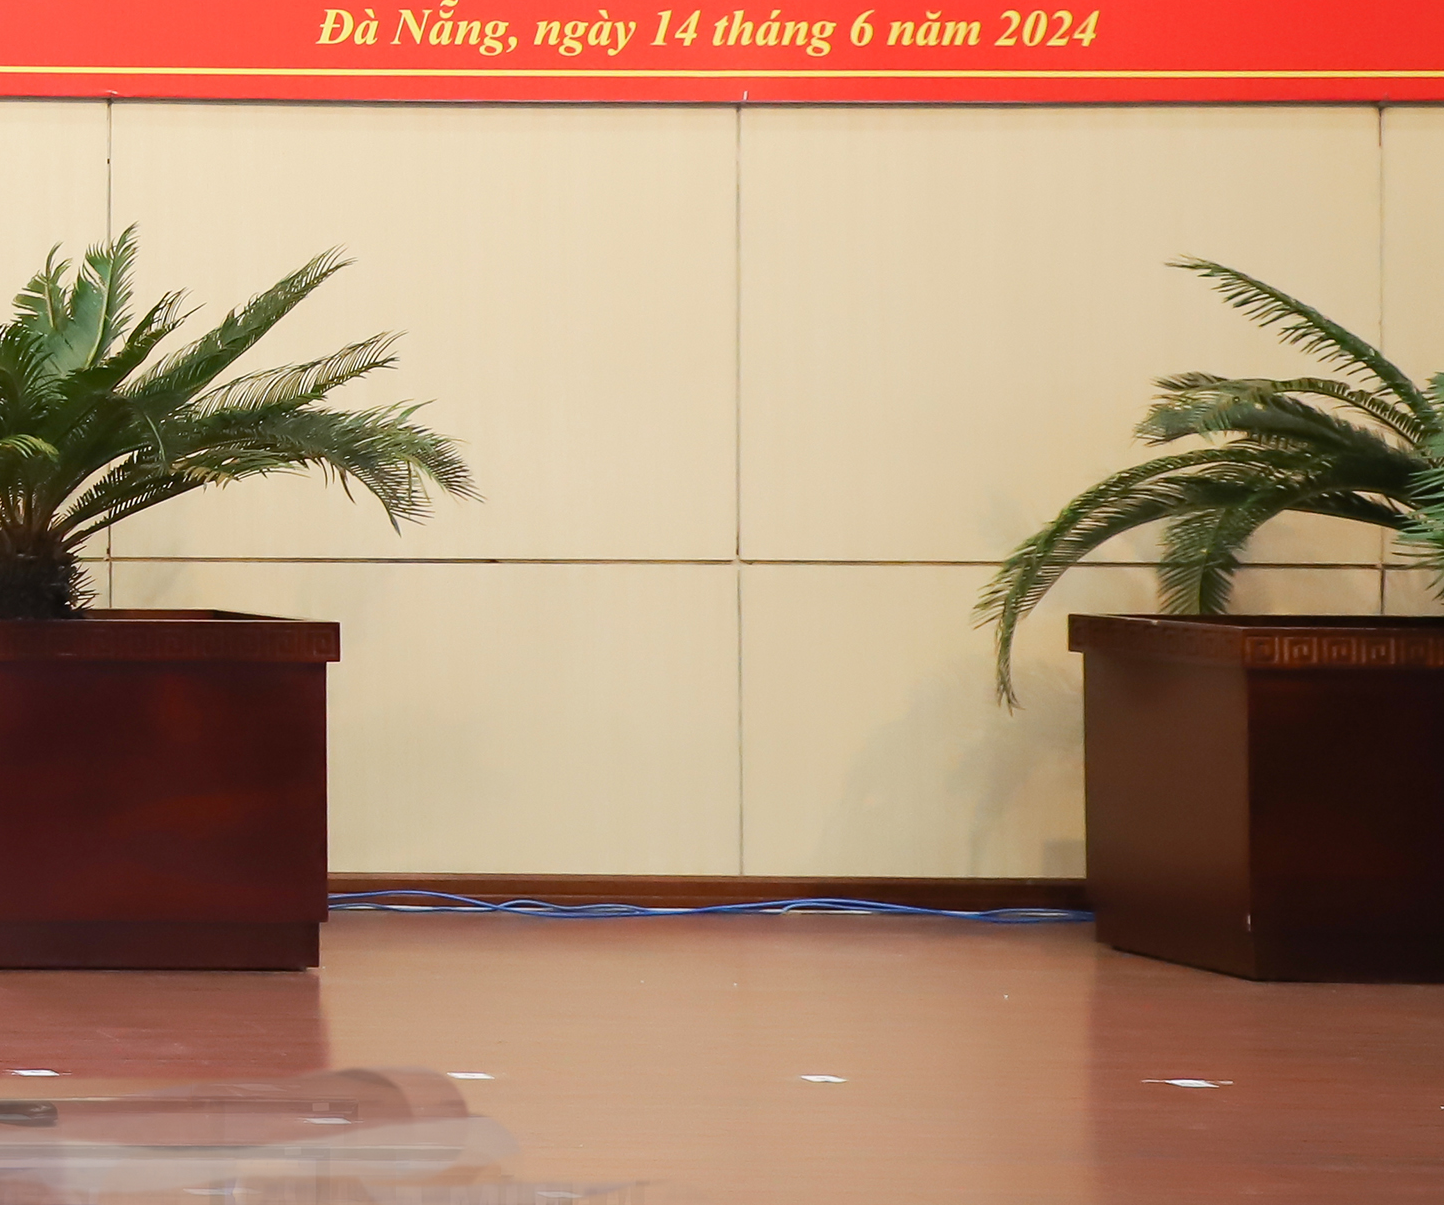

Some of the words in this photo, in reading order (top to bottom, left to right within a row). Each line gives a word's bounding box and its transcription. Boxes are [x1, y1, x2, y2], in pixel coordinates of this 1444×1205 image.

[315, 8, 379, 45] Đà
[533, 9, 637, 57] ngày
[651, 10, 701, 46] 14
[712, 9, 837, 57] tháng
[850, 10, 874, 46] 6
[887, 11, 981, 46] năm
[994, 10, 1100, 47] 2024
